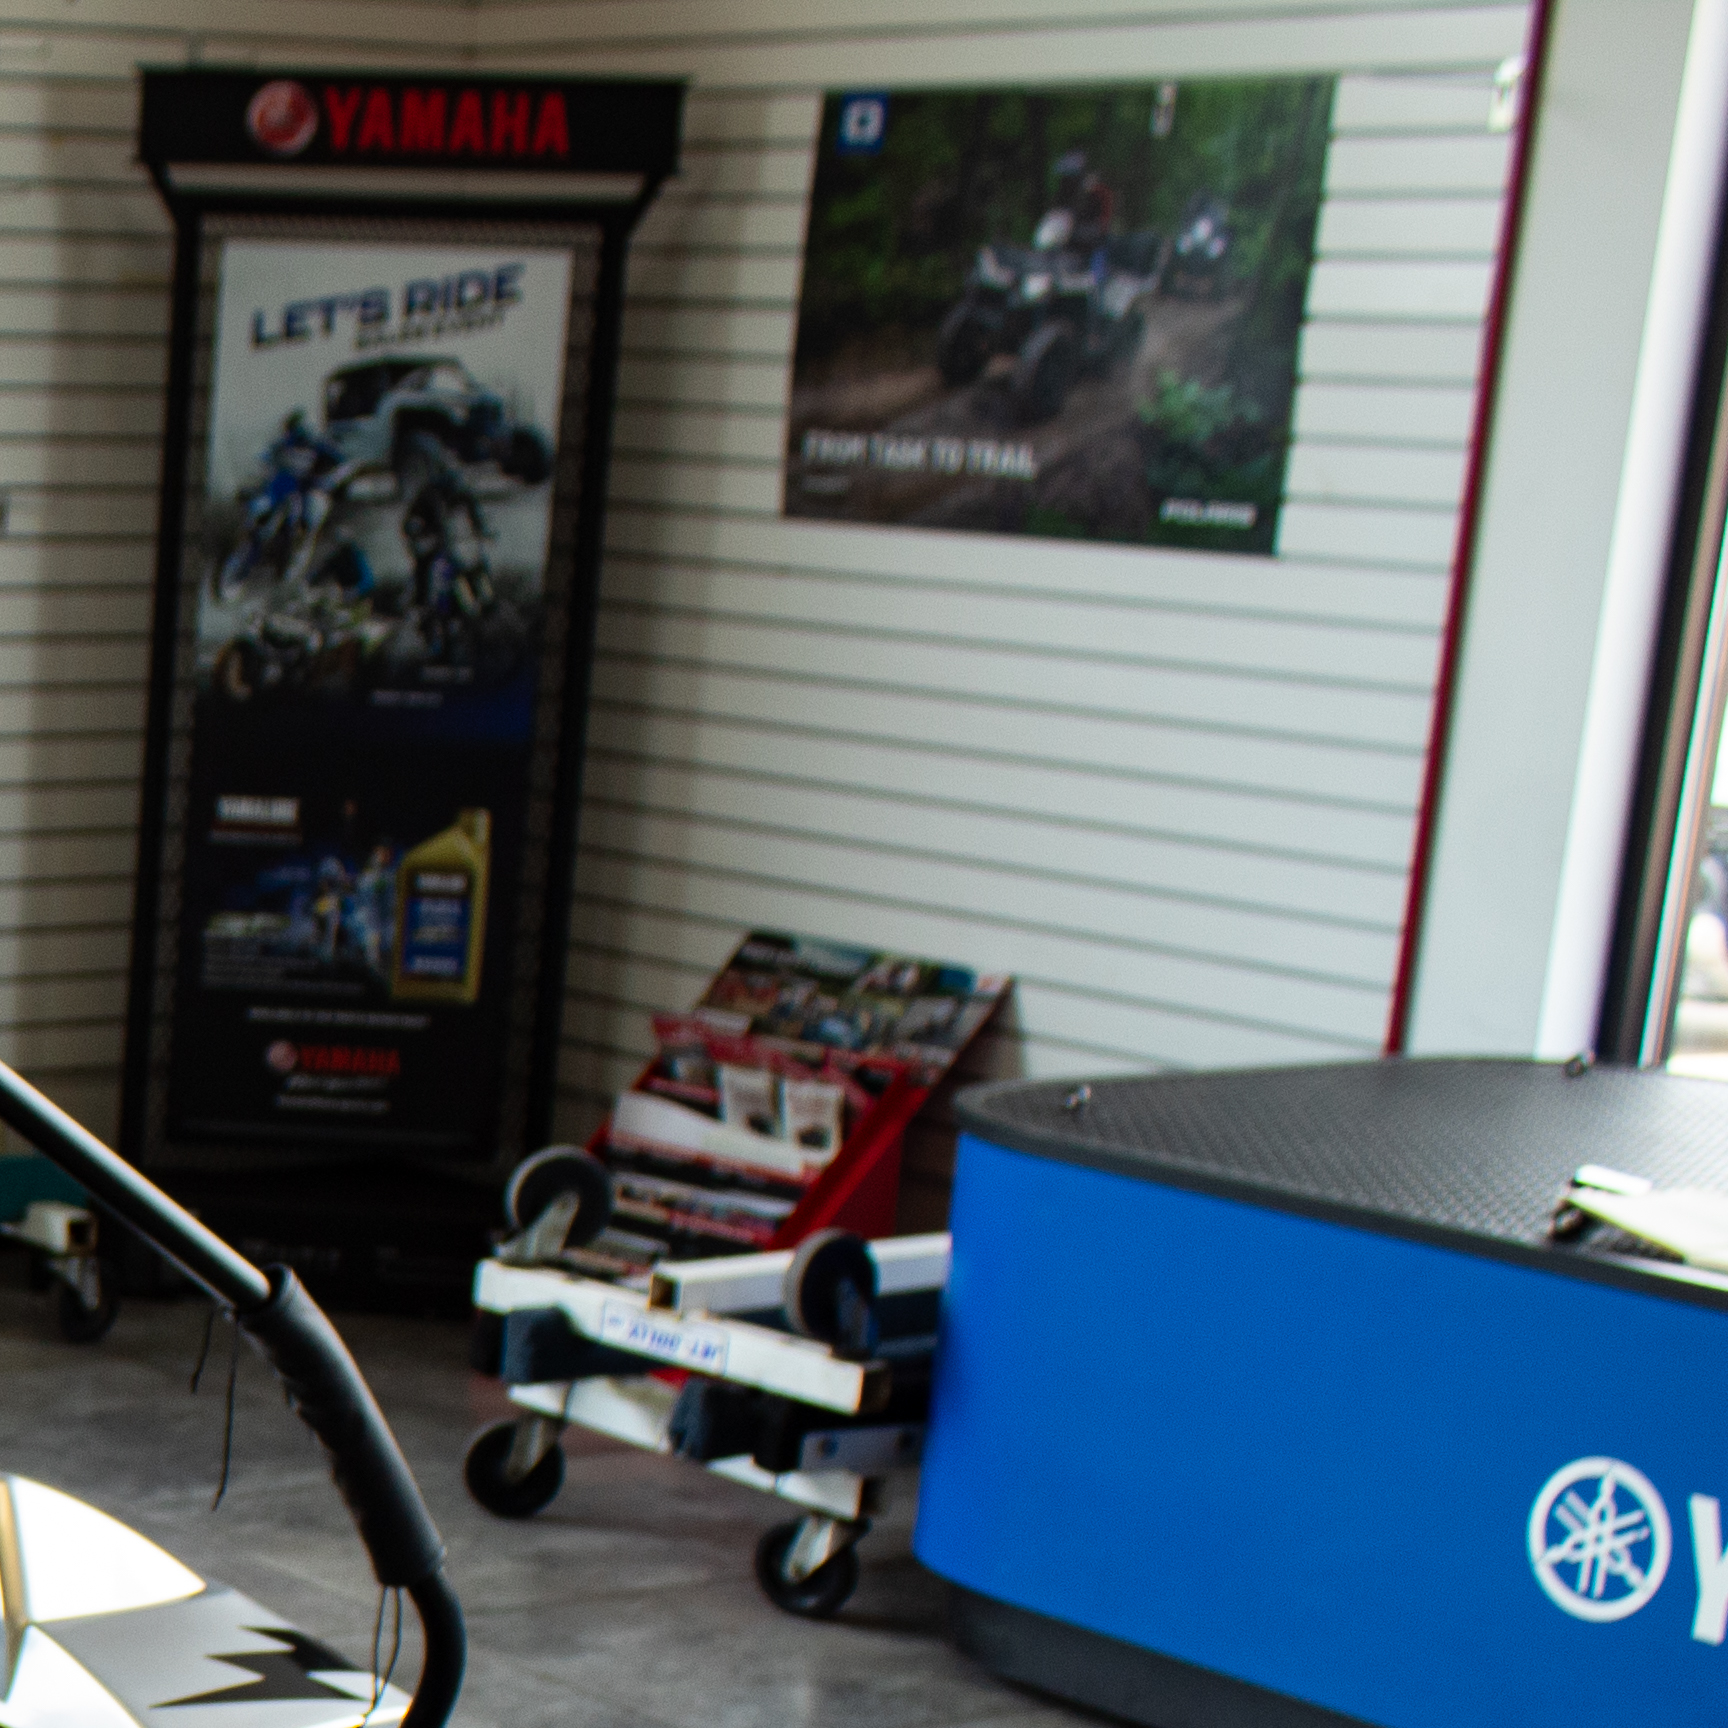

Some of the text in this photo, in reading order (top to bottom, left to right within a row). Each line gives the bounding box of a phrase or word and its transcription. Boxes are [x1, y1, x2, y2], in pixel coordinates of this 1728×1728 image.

[324, 85, 569, 155] YAMAHA
[251, 285, 393, 346] LET'S
[405, 262, 526, 316] RIDE
[931, 436, 964, 475] TO
